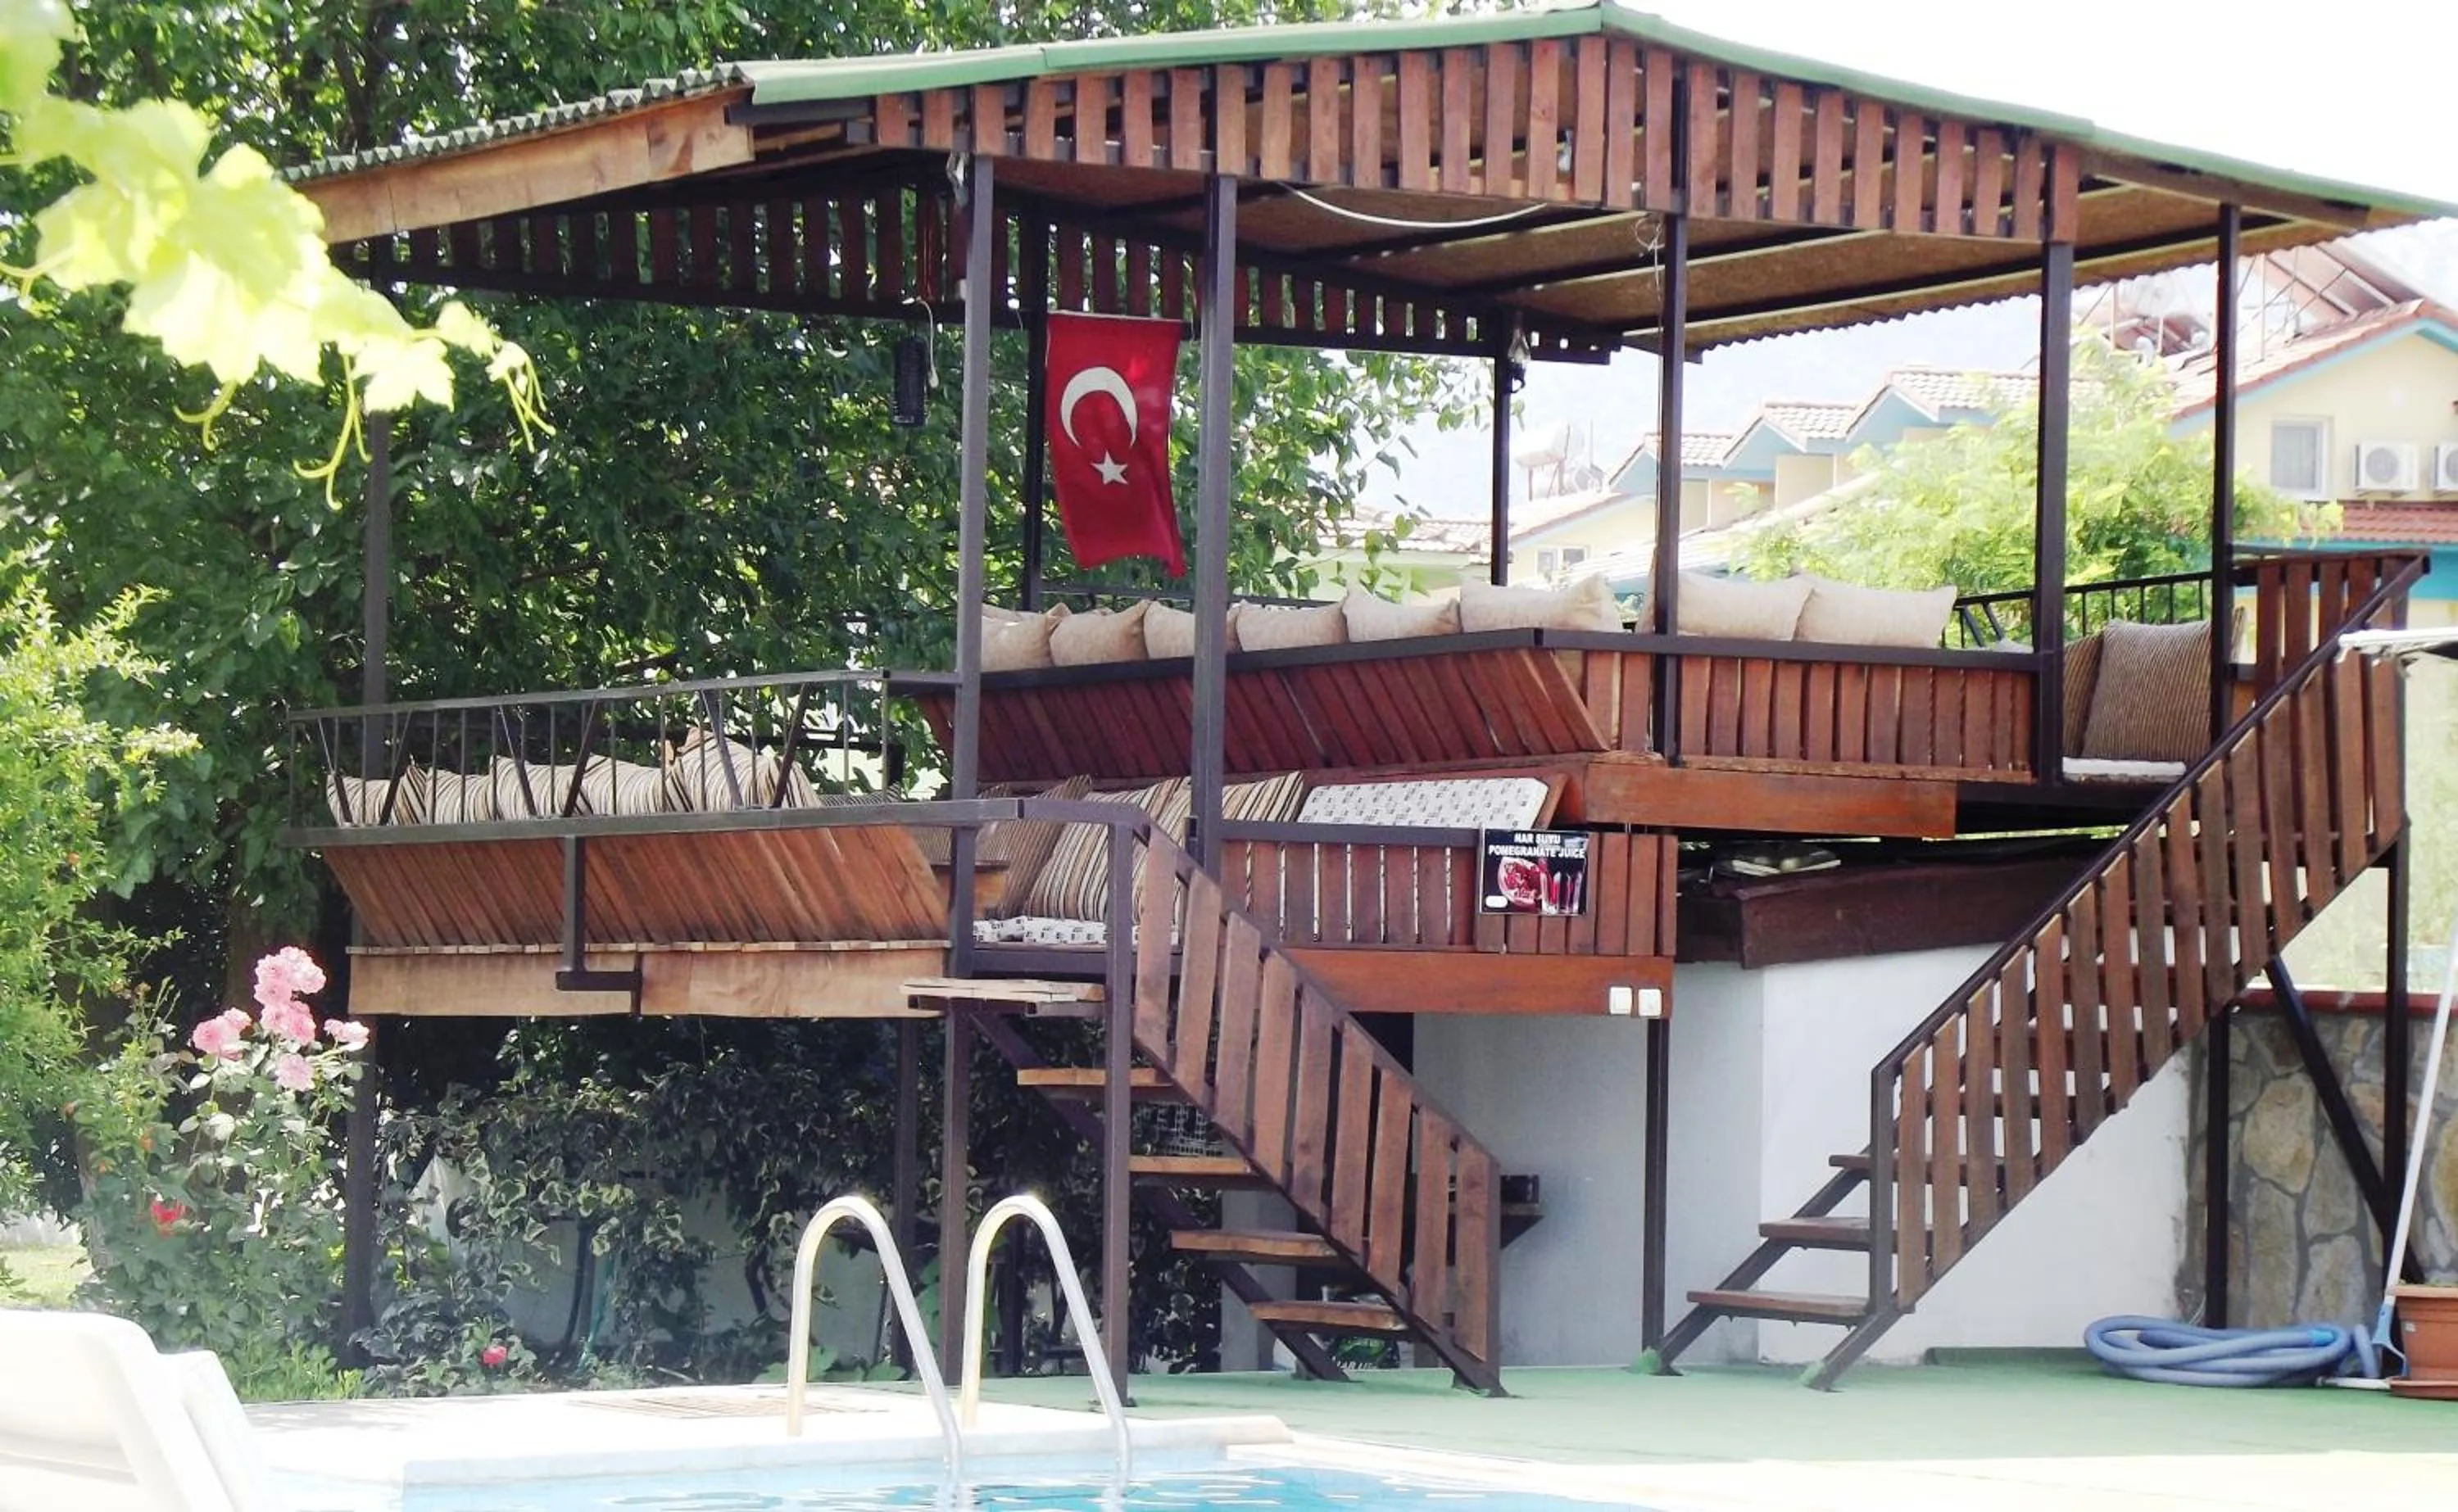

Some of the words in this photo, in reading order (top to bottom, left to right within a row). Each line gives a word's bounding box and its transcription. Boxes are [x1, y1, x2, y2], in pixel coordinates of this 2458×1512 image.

[1514, 833, 1534, 844] NAR
[1535, 834, 1561, 844] SUYU
[1489, 845, 1557, 857] POMEGRANATE
[1558, 849, 1585, 858] JUICE
